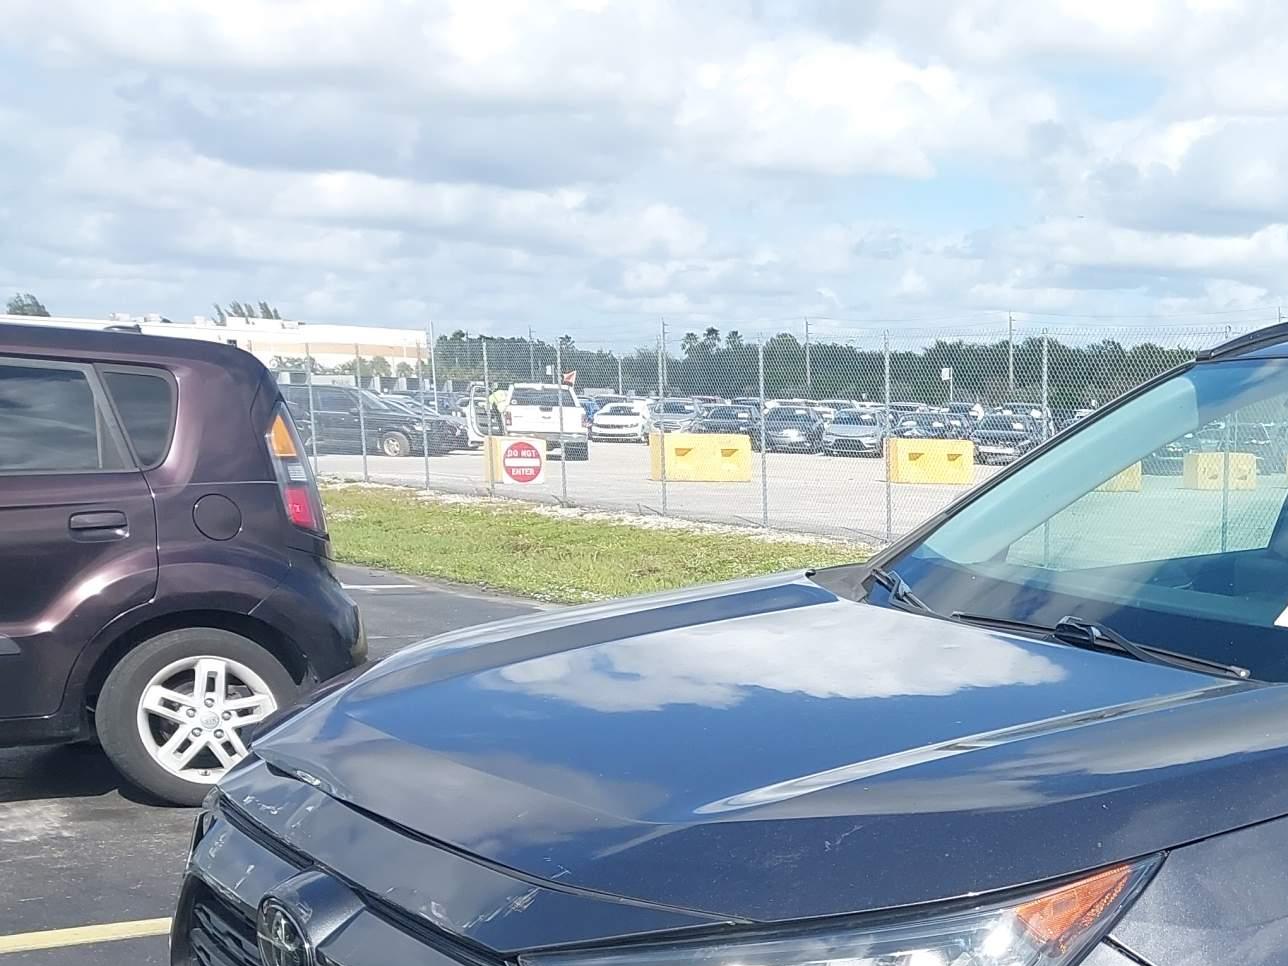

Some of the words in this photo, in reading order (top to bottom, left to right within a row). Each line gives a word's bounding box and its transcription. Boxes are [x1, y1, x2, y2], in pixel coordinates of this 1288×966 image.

[507, 449, 519, 457] DO
[521, 449, 537, 457] NOT
[511, 467, 535, 476] ENTER
